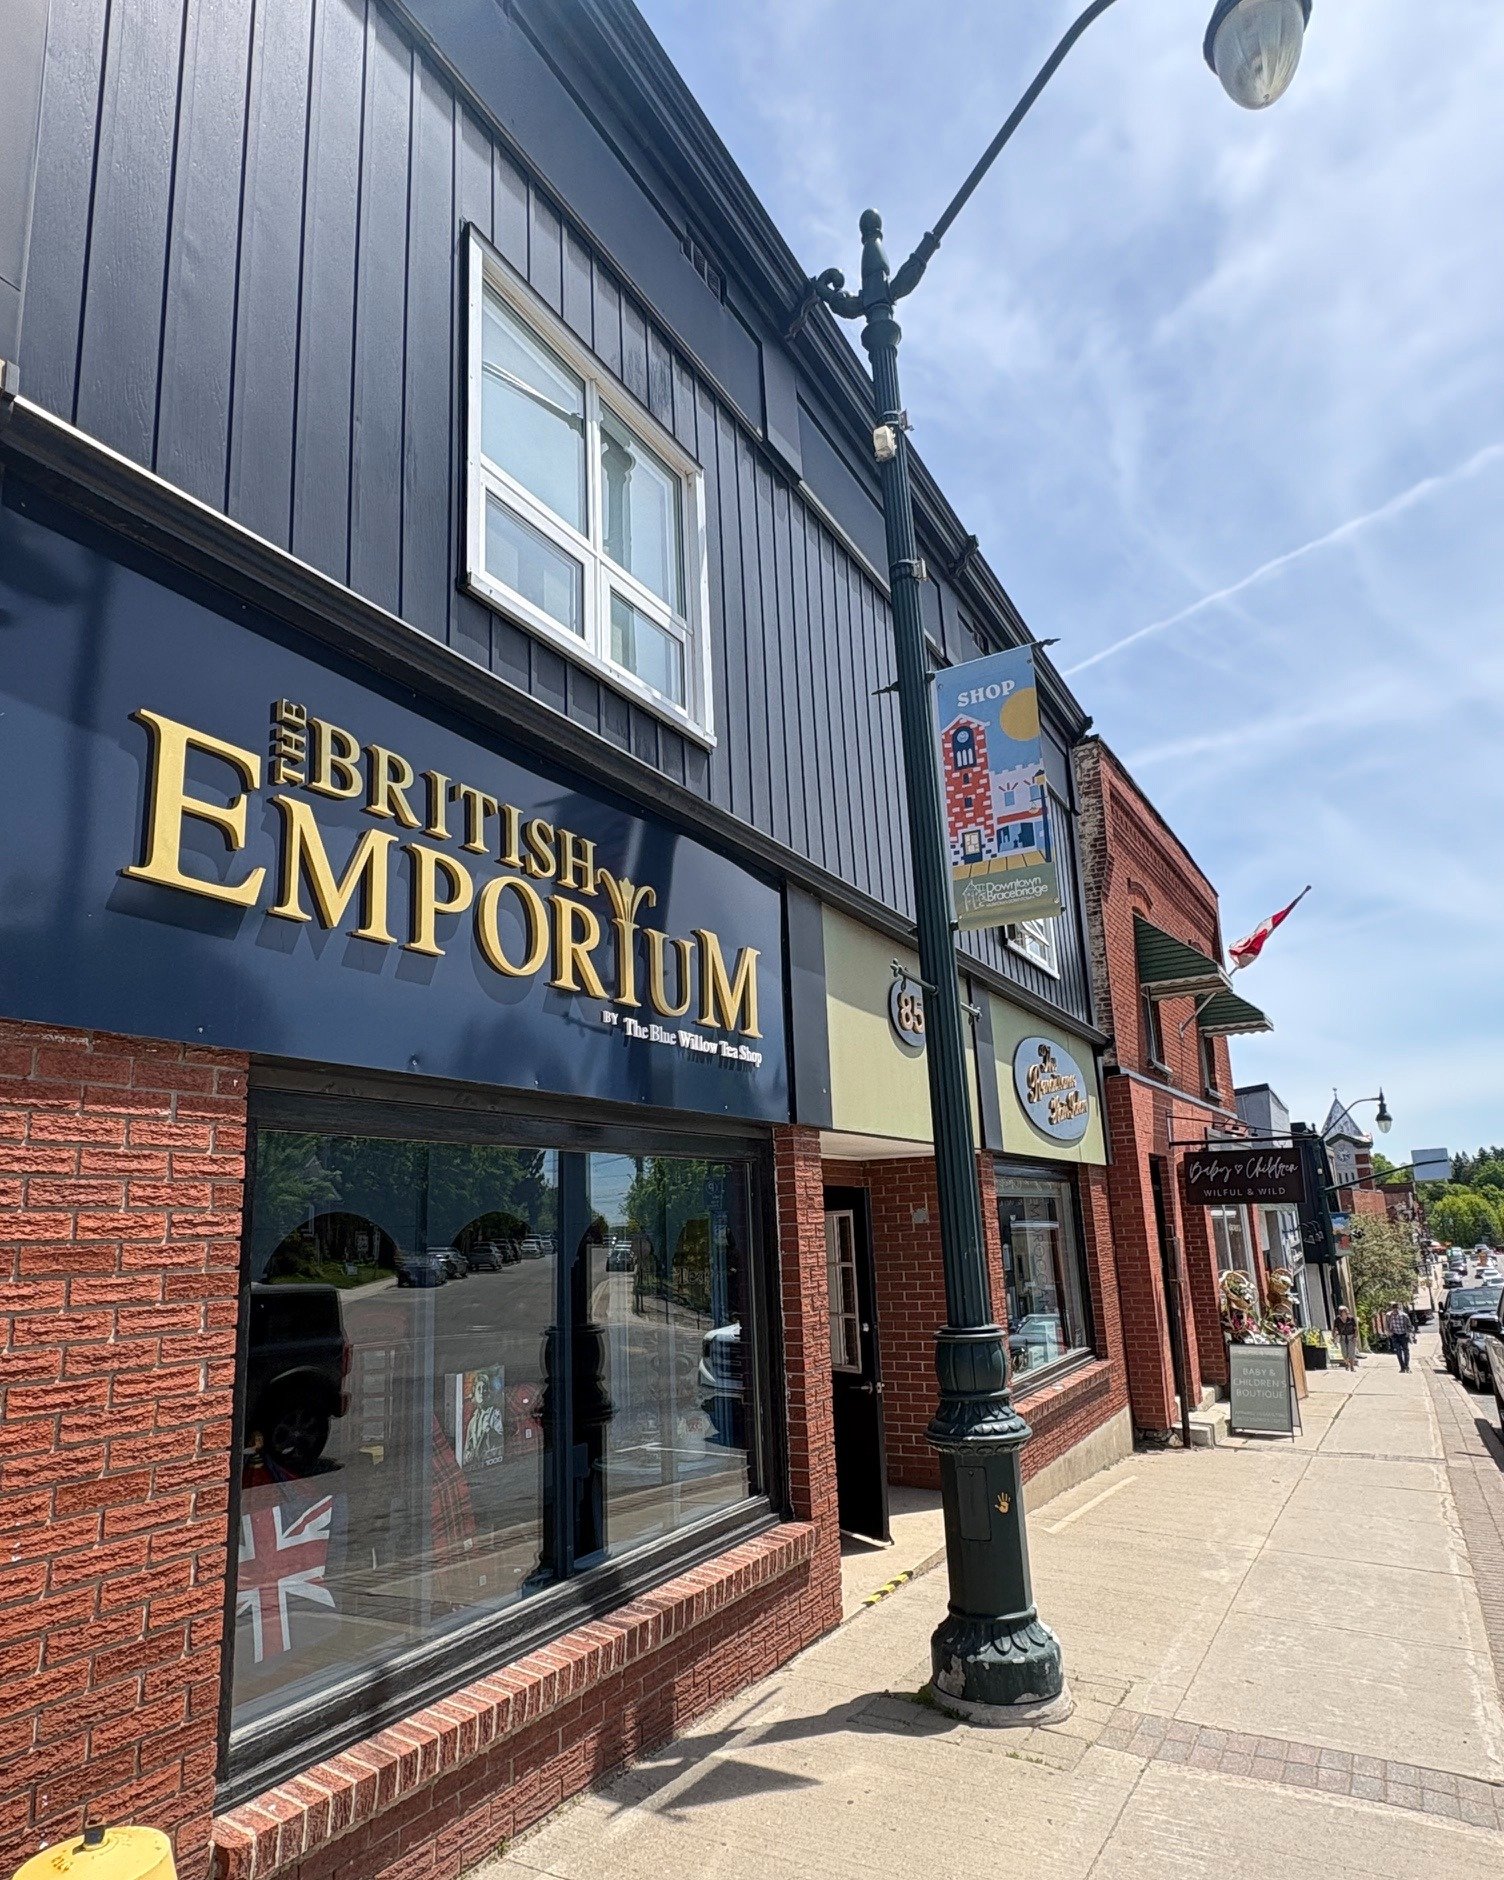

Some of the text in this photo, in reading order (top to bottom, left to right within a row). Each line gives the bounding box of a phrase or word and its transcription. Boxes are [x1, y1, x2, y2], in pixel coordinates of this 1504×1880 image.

[957, 679, 1015, 707] SHOP
[274, 698, 598, 897] THE BRITISH
[122, 707, 764, 1038] EMPORIUM
[986, 876, 1042, 893] Downtown
[987, 884, 1048, 902] Bracebridge
[602, 1010, 763, 1068] BY The Blue Willow Tea Shop
[1189, 1156, 1299, 1184] Baby Children
[1204, 1187, 1286, 1197] WILFUL & WILD
[1242, 1367, 1276, 1376] BABY &
[1236, 1388, 1285, 1399] BOUTIQUE
